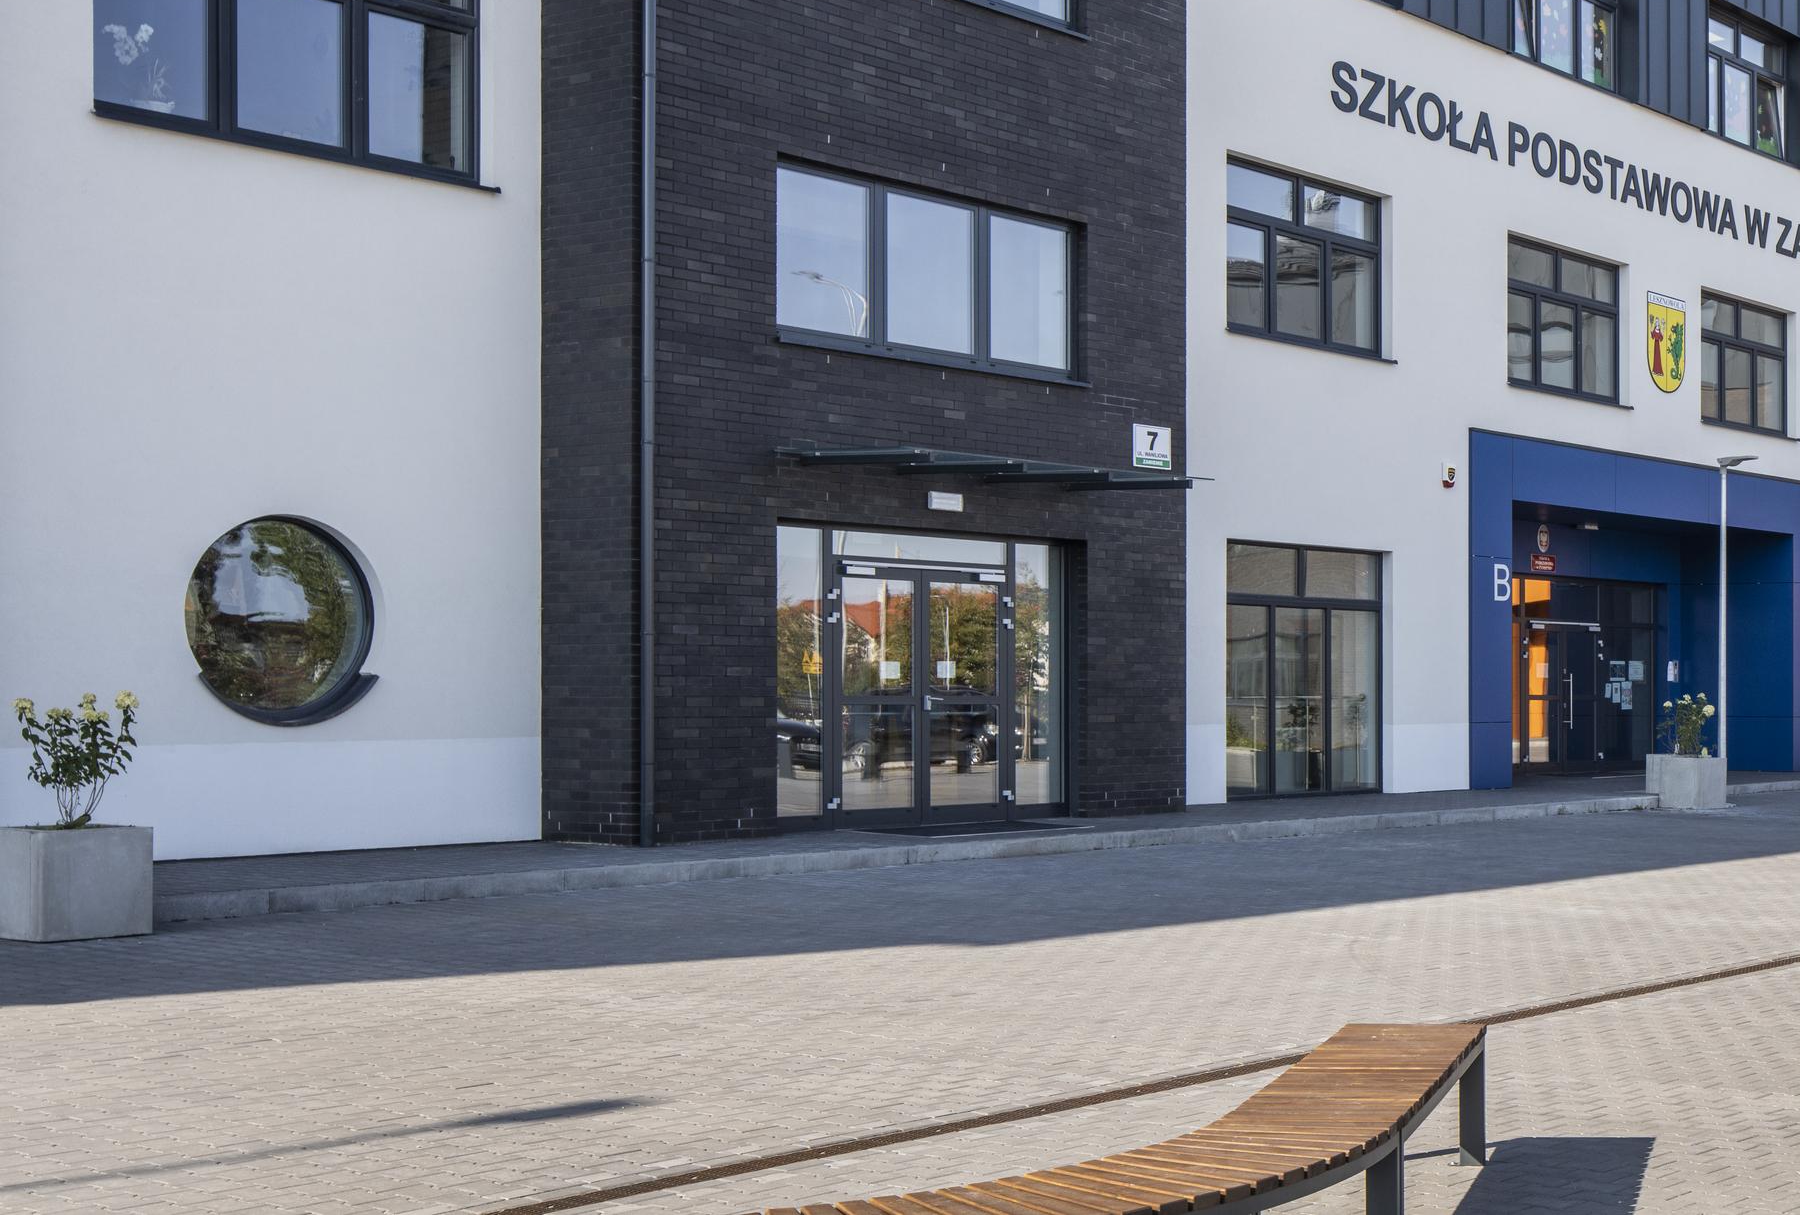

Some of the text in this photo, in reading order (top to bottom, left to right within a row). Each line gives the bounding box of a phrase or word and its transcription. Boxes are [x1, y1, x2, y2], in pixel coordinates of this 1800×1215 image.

[1330, 60, 1498, 161] SZKOŁA
[1508, 122, 1738, 241] PODSTAWOWA
[1745, 204, 1770, 248] W
[1147, 431, 1158, 451] 7
[1494, 563, 1511, 602] B
